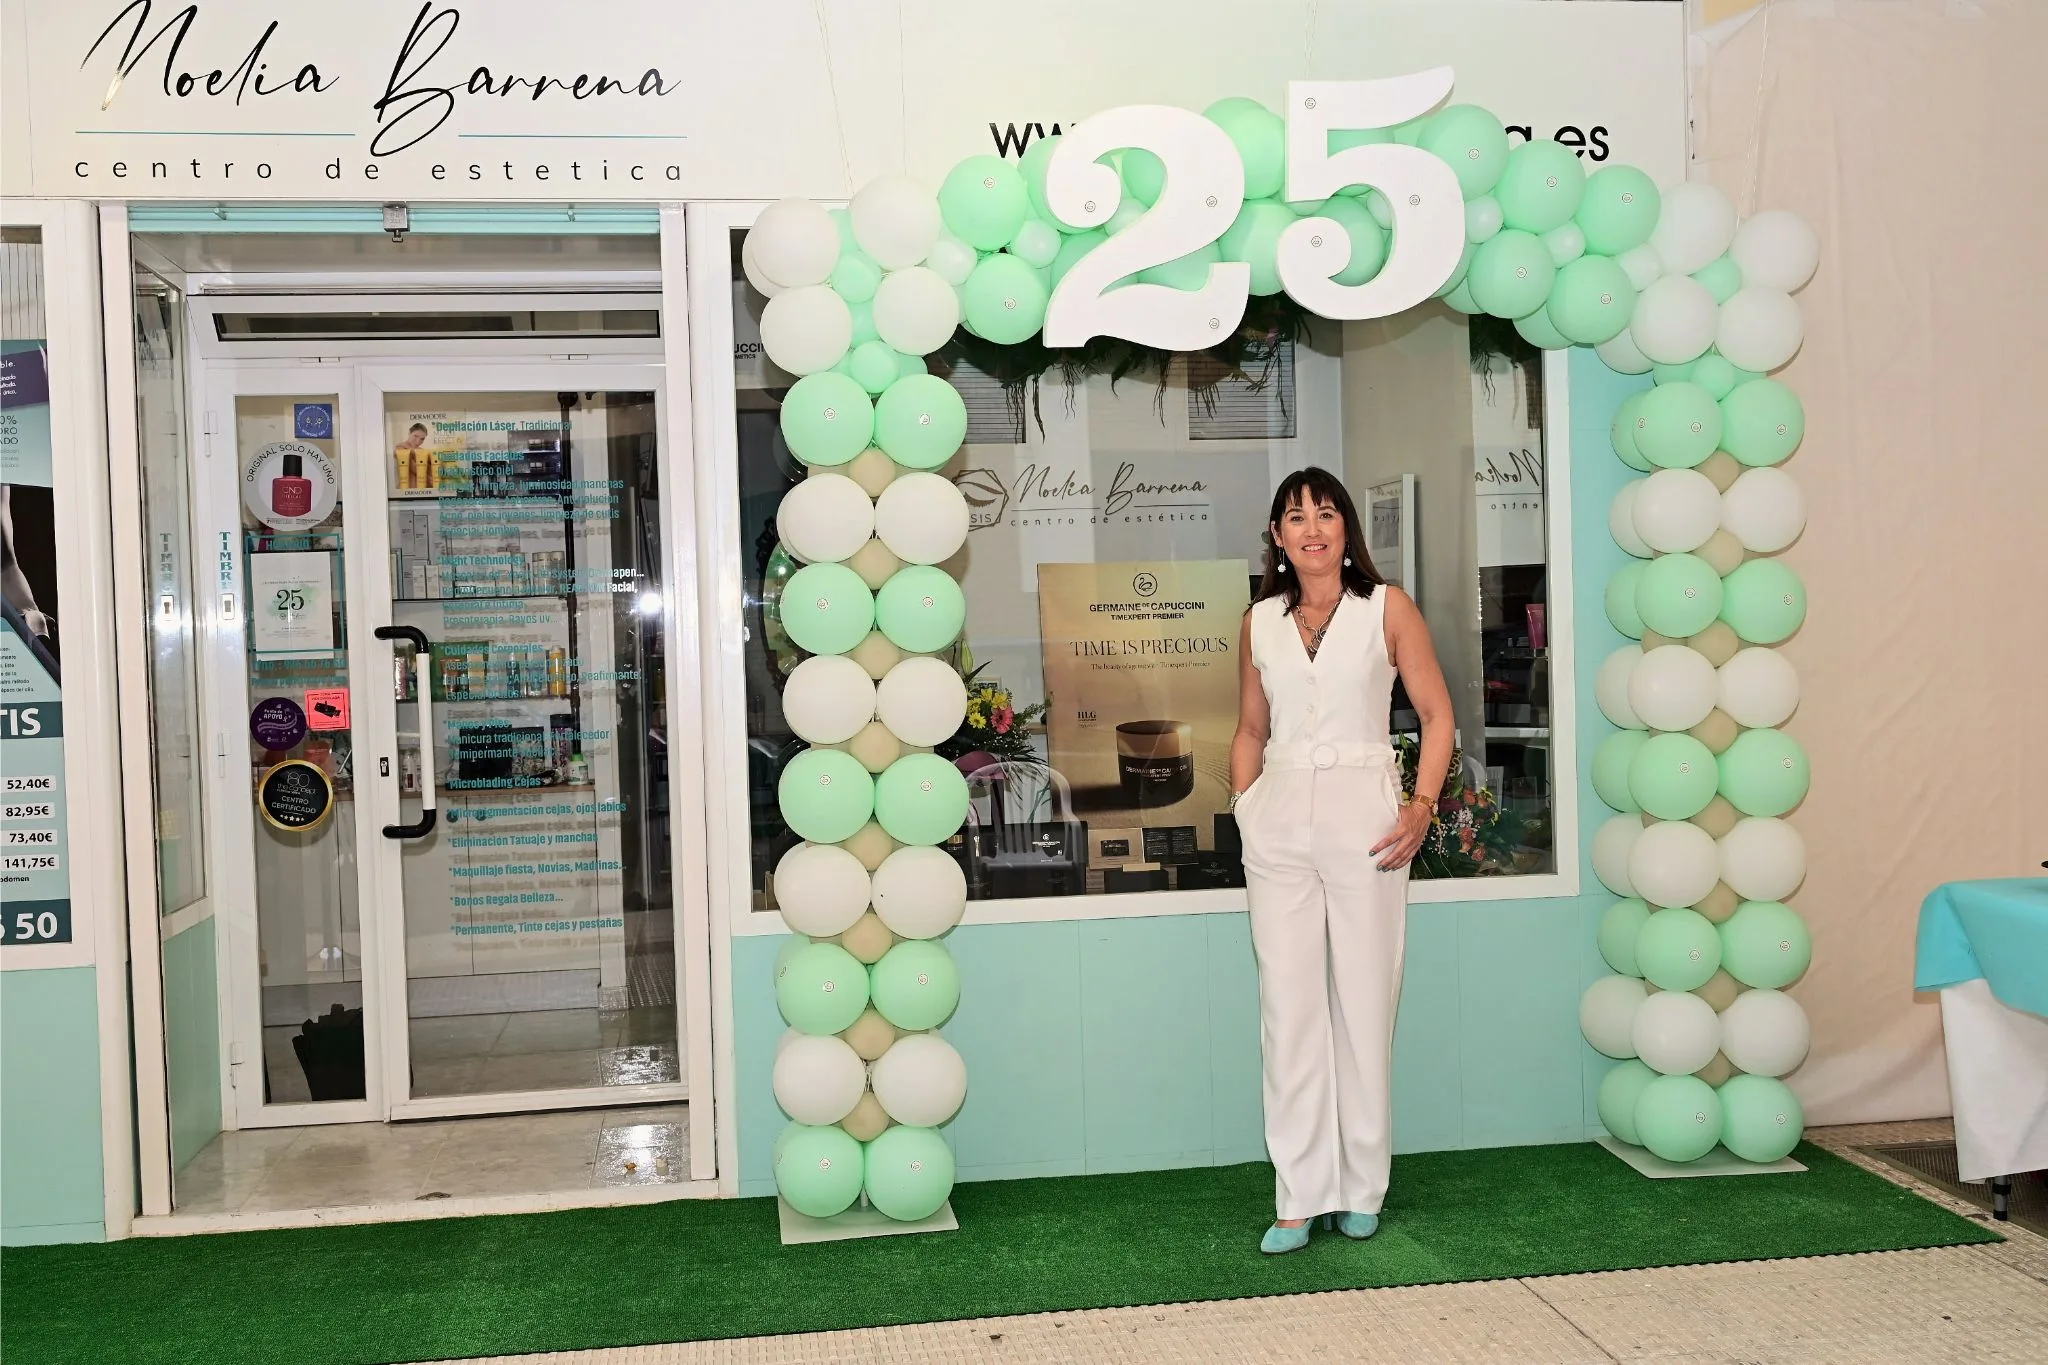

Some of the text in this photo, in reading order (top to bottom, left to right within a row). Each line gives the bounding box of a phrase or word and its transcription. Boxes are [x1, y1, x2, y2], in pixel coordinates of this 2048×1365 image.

[80, 0, 682, 157] Noelia Barrena
[74, 157, 682, 182] centro de estetica
[1043, 66, 1467, 351] 25
[247, 444, 335, 485] ORIGINAL SOLO HAY UNO
[1012, 462, 1209, 516] Noelia Barrena
[1010, 516, 1075, 528] centro
[1090, 515, 1109, 525] de
[276, 589, 305, 611] 25
[1089, 602, 1142, 612] GERMAINE
[1150, 601, 1205, 611] CAPUCCINI
[1110, 612, 1185, 621] TIMEXPERT PREMIER
[1069, 637, 1229, 656] TIME IS PRECIOUS
[7, 778, 50, 790] 52,40€
[281, 795, 309, 805] CENTRO
[5, 805, 49, 817] 82,95€
[271, 802, 317, 814] CERTIFICADO
[9, 832, 53, 844] 73,40€
[509, 834, 546, 847] Tatuaje
[555, 832, 599, 843] manchas
[4, 857, 55, 869] 141,75€
[505, 863, 537, 876] fiesta,
[538, 862, 574, 875] Novias,
[486, 893, 519, 907] Regala
[15, 911, 58, 939] 50
[518, 921, 543, 934] Tinte
[544, 920, 571, 934] cejas
[579, 918, 624, 931] pestañas
